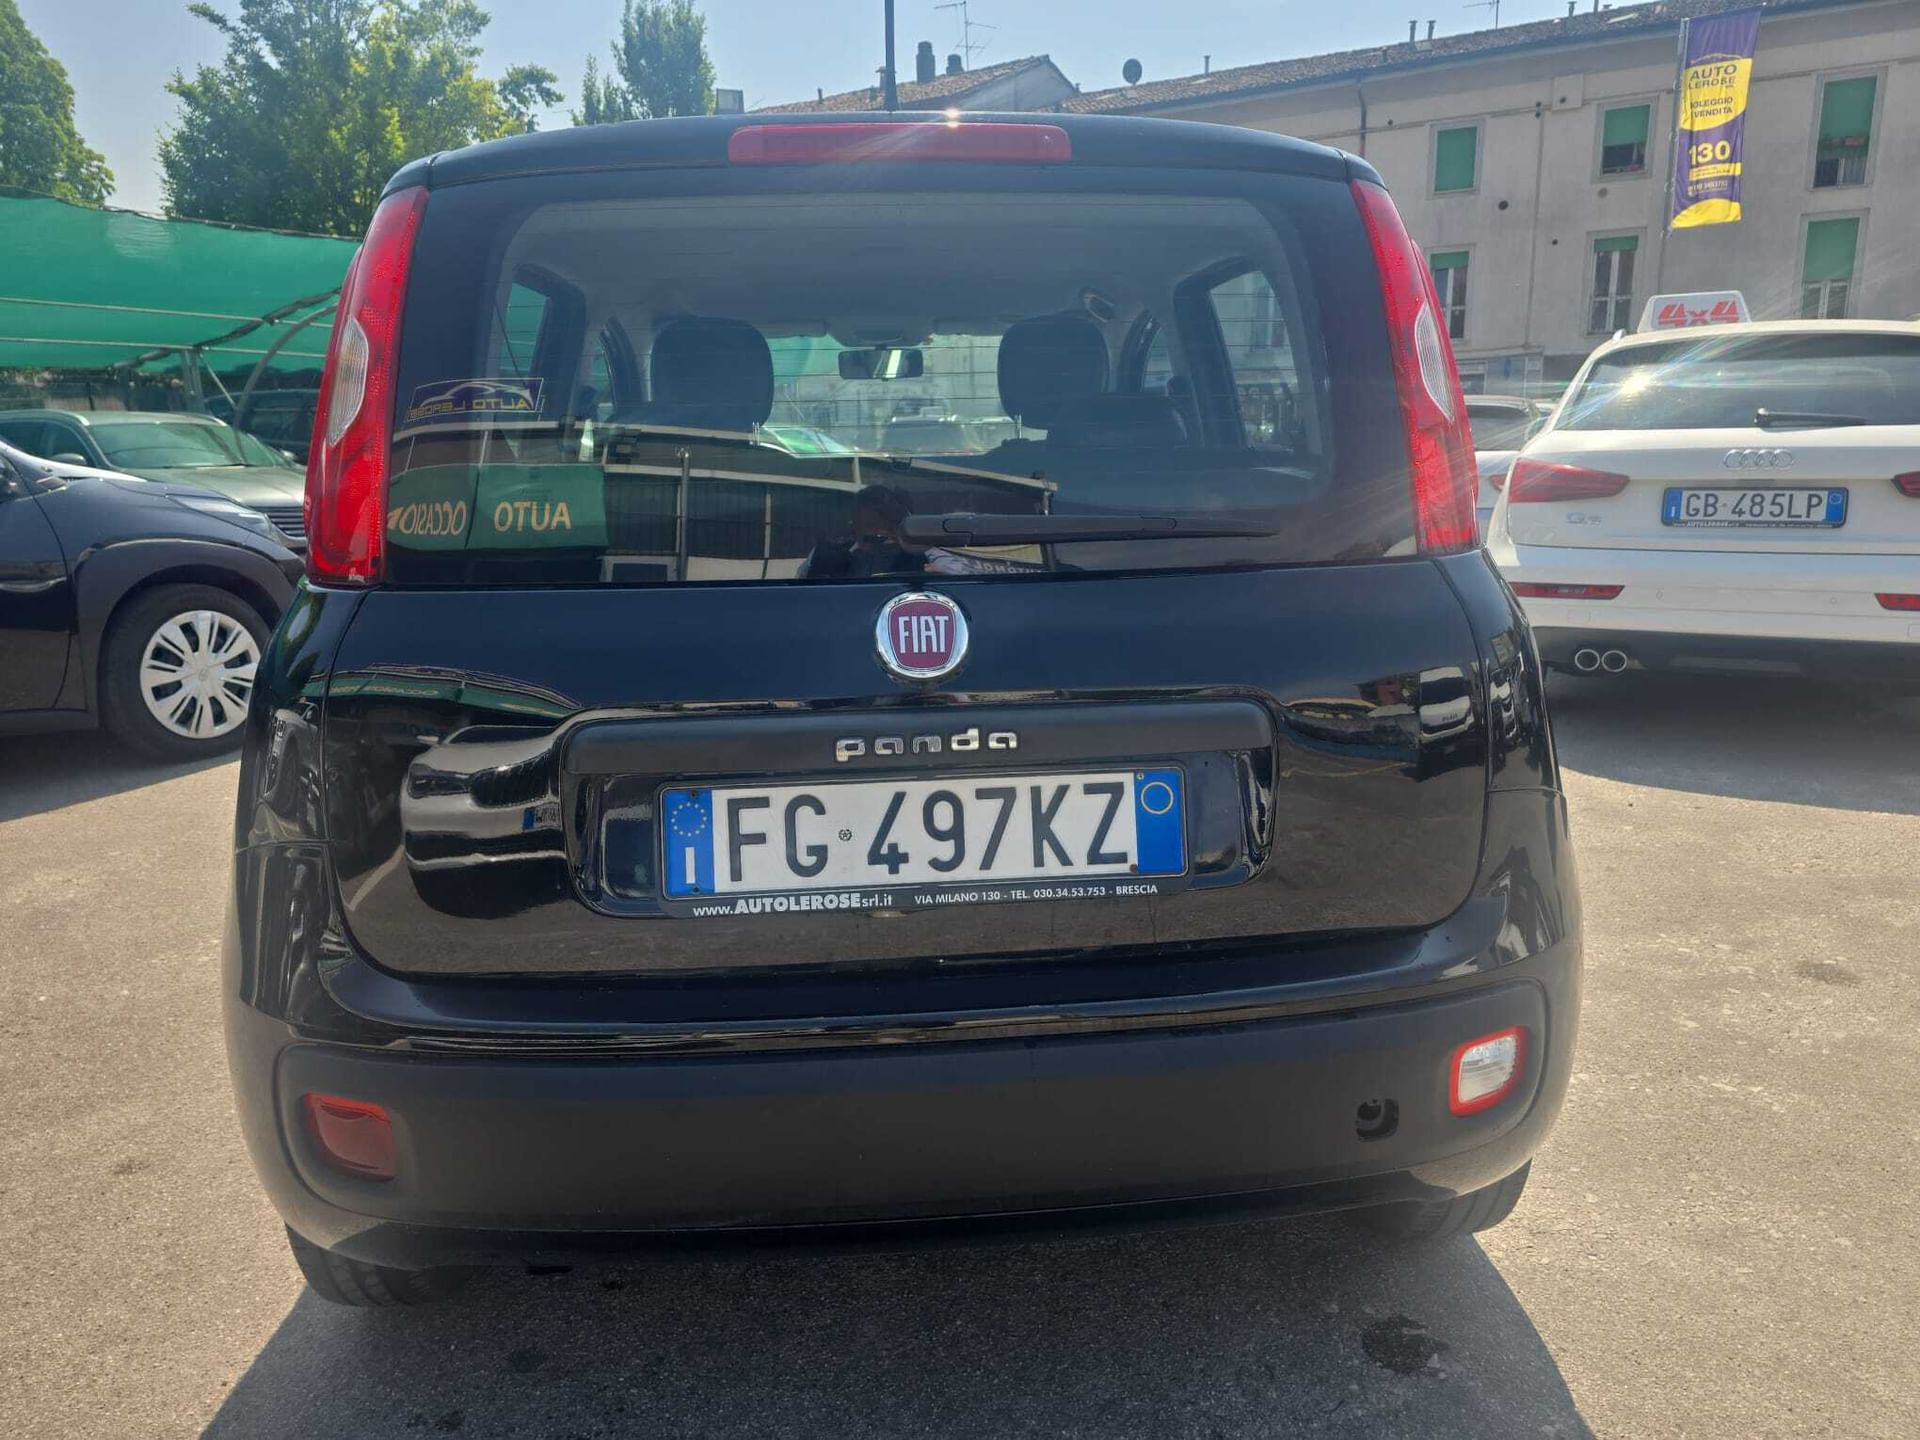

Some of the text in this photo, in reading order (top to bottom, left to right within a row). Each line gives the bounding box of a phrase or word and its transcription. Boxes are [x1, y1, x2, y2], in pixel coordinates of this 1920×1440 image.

[1688, 76, 1736, 90] LEROSE
[1690, 64, 1737, 81] AUTO
[1694, 107, 1732, 118] VENDITA
[1688, 140, 1731, 165] 130
[1686, 493, 1719, 518] GB
[1731, 493, 1823, 518] 485LP
[898, 615, 949, 654] FIAT
[836, 728, 1018, 762] panda
[727, 794, 829, 883] FG
[867, 781, 1129, 876] 497KZ
[693, 893, 893, 917] www.AUTOLEROSEsrl.it
[914, 894, 934, 905] VIA
[935, 891, 979, 904] MILANO
[982, 890, 1001, 901] 130
[1010, 889, 1031, 900] TEL.
[1033, 886, 1106, 899] 030.34.53.753
[1116, 884, 1158, 896] BRESCIA
